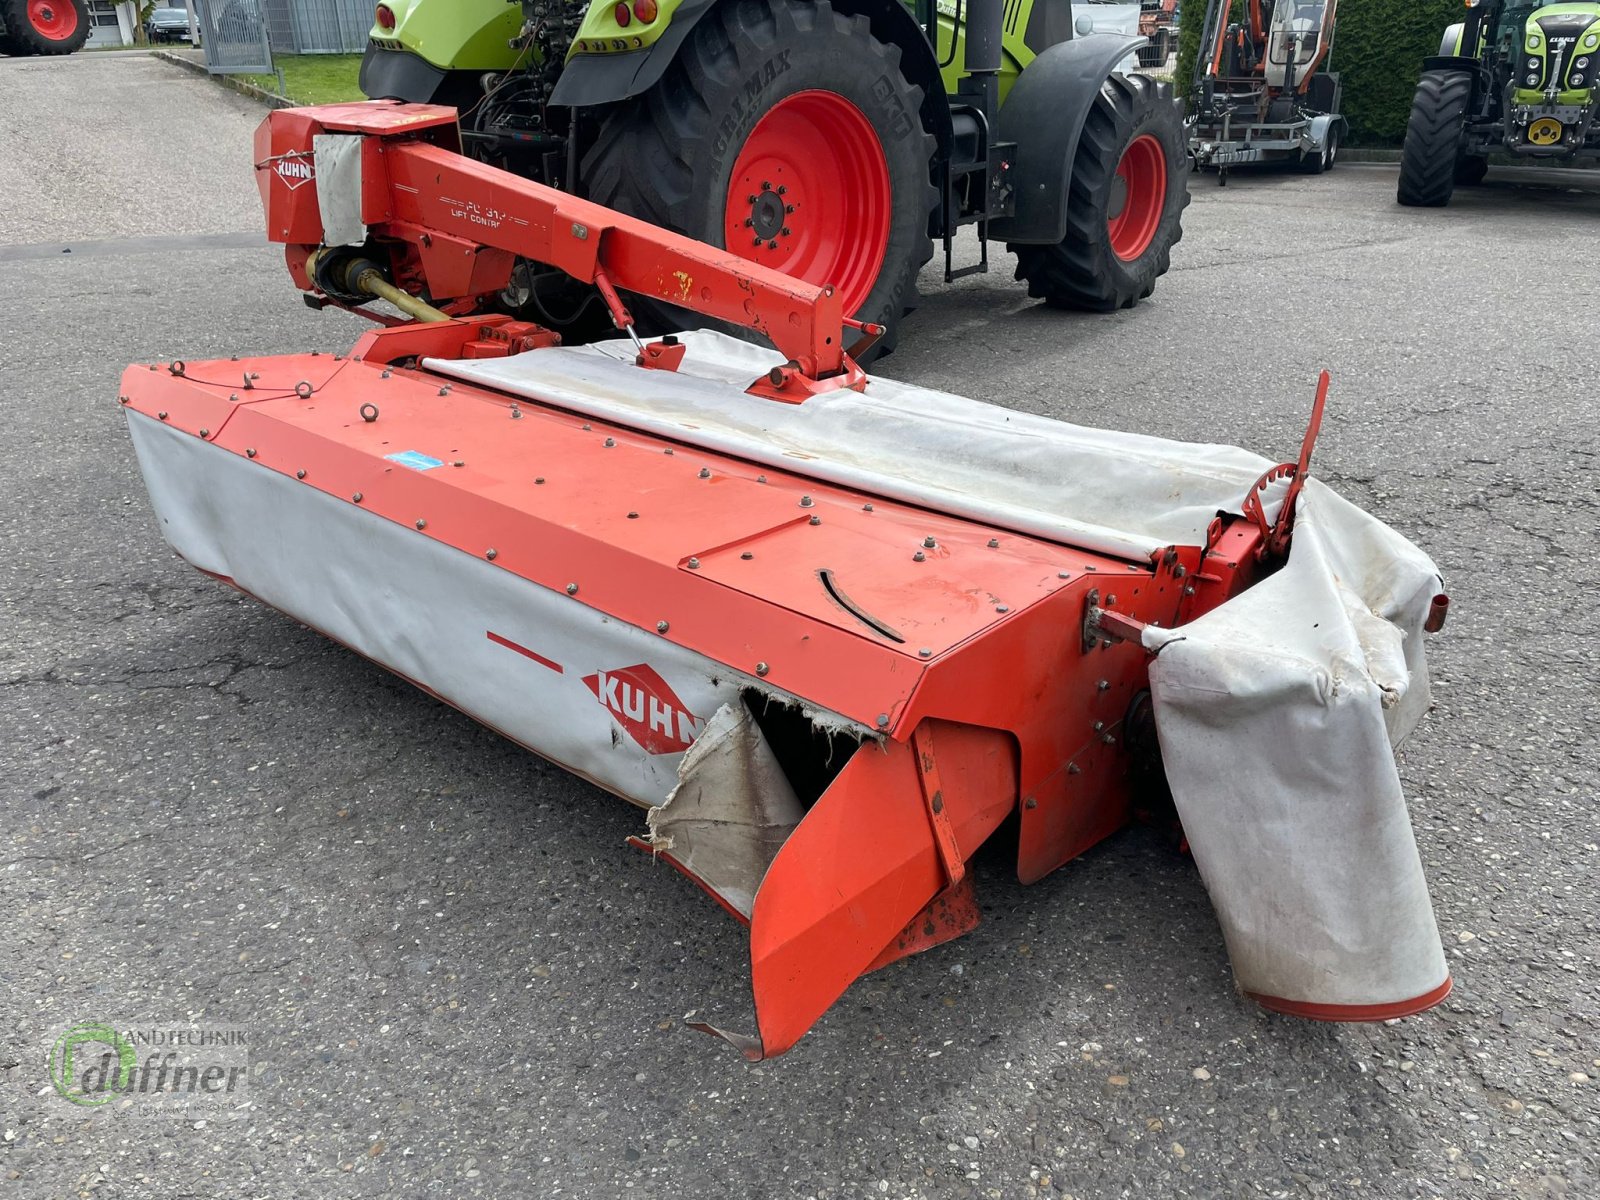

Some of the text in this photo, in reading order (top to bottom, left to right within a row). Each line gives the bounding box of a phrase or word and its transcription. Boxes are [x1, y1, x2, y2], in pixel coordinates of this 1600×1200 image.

[277, 159, 312, 179] KUHN
[451, 209, 501, 229] LIFT CONTR
[598, 669, 707, 745] KUHN
